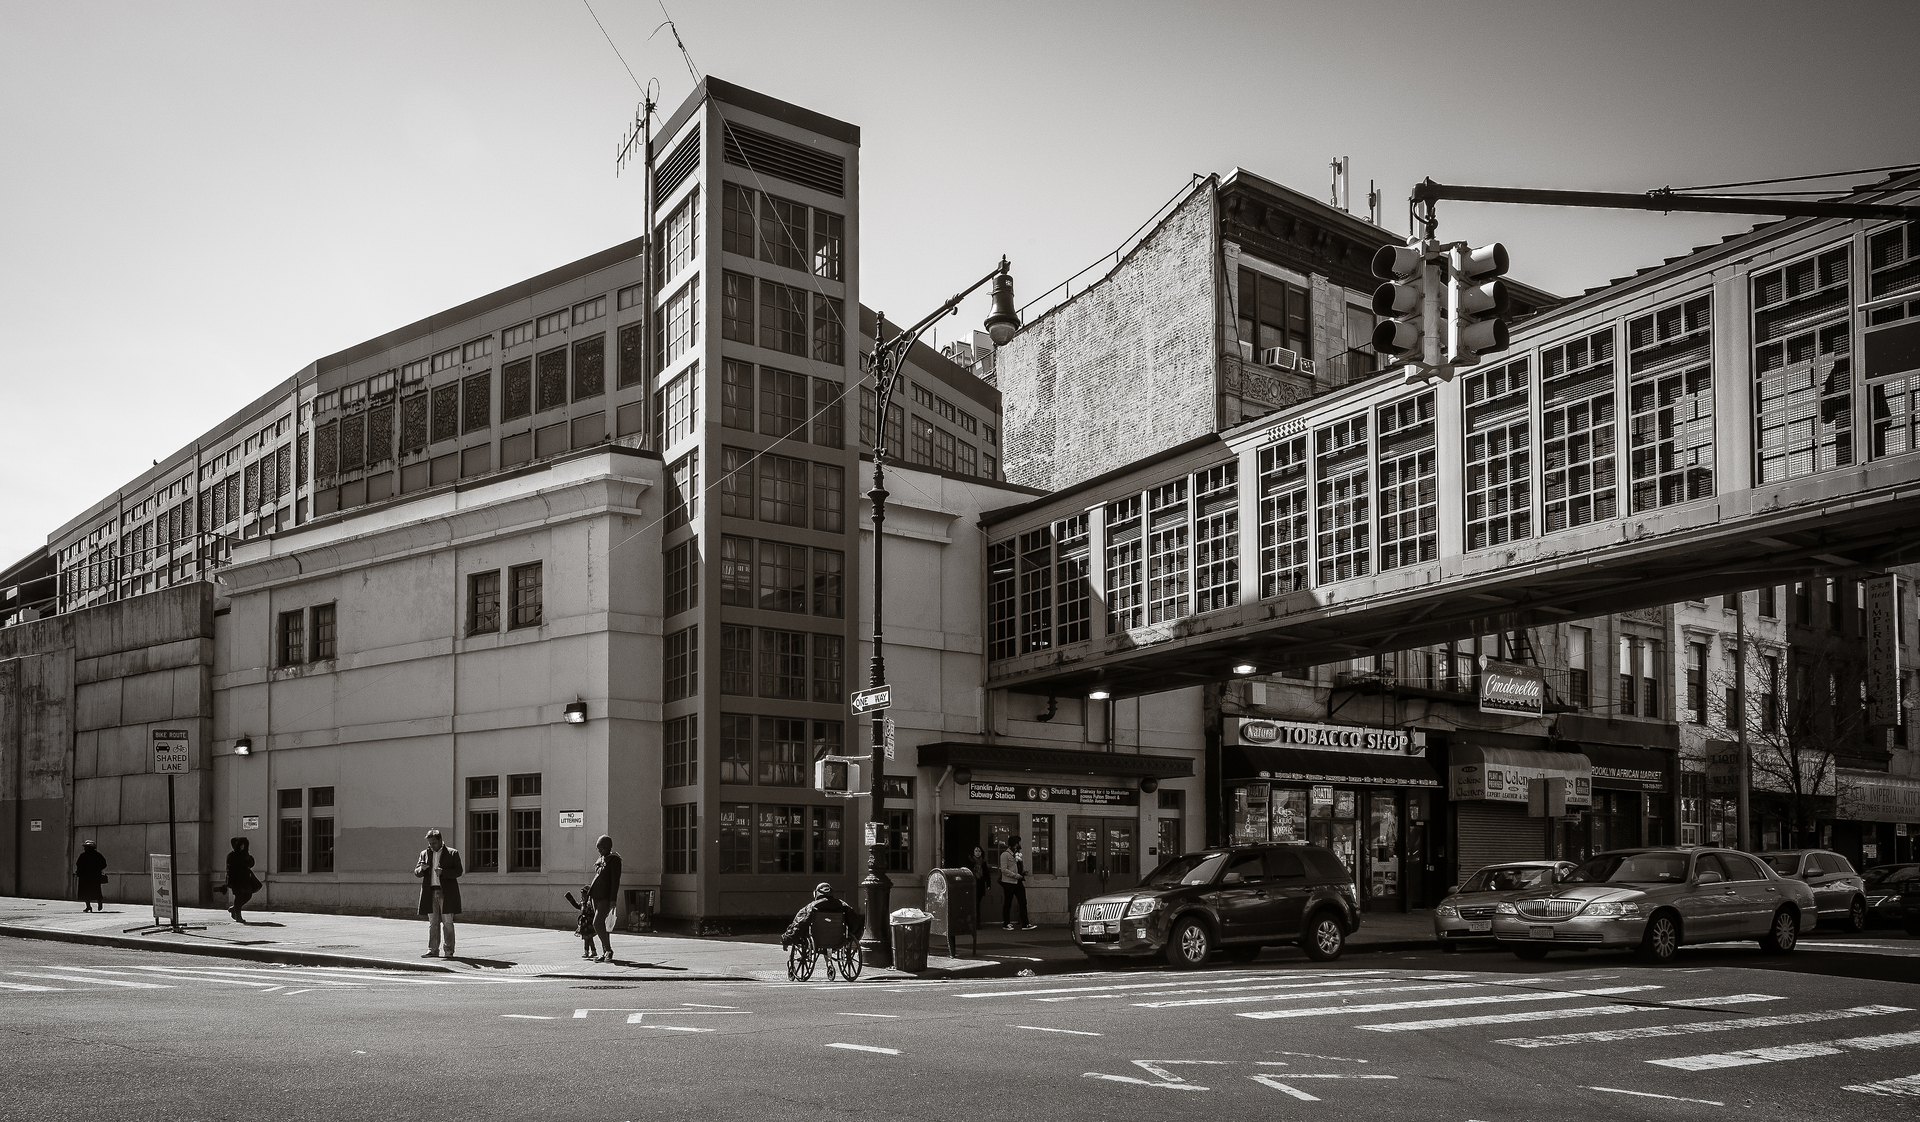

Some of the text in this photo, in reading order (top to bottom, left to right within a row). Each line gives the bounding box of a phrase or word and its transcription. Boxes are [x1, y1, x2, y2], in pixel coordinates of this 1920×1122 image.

[1485, 673, 1540, 697] Cinderella
[855, 692, 888, 708] ONE WAY
[169, 731, 187, 739] ROUTE
[1247, 725, 1277, 740] Natural
[1283, 726, 1409, 751] TOBACCO SHOP
[156, 754, 187, 762] SHARED
[1712, 754, 1740, 764] LIQU
[161, 763, 182, 771] LANE
[1591, 765, 1662, 780] ROOKLYN AFRICAN MARKET
[970, 783, 1015, 792] Franklin Avenue
[1050, 787, 1070, 795] Shuttle
[970, 790, 1016, 800] Subway Station
[1870, 787, 1901, 804] IMPERIAL
[1882, 804, 1916, 815] RESTAURANT
